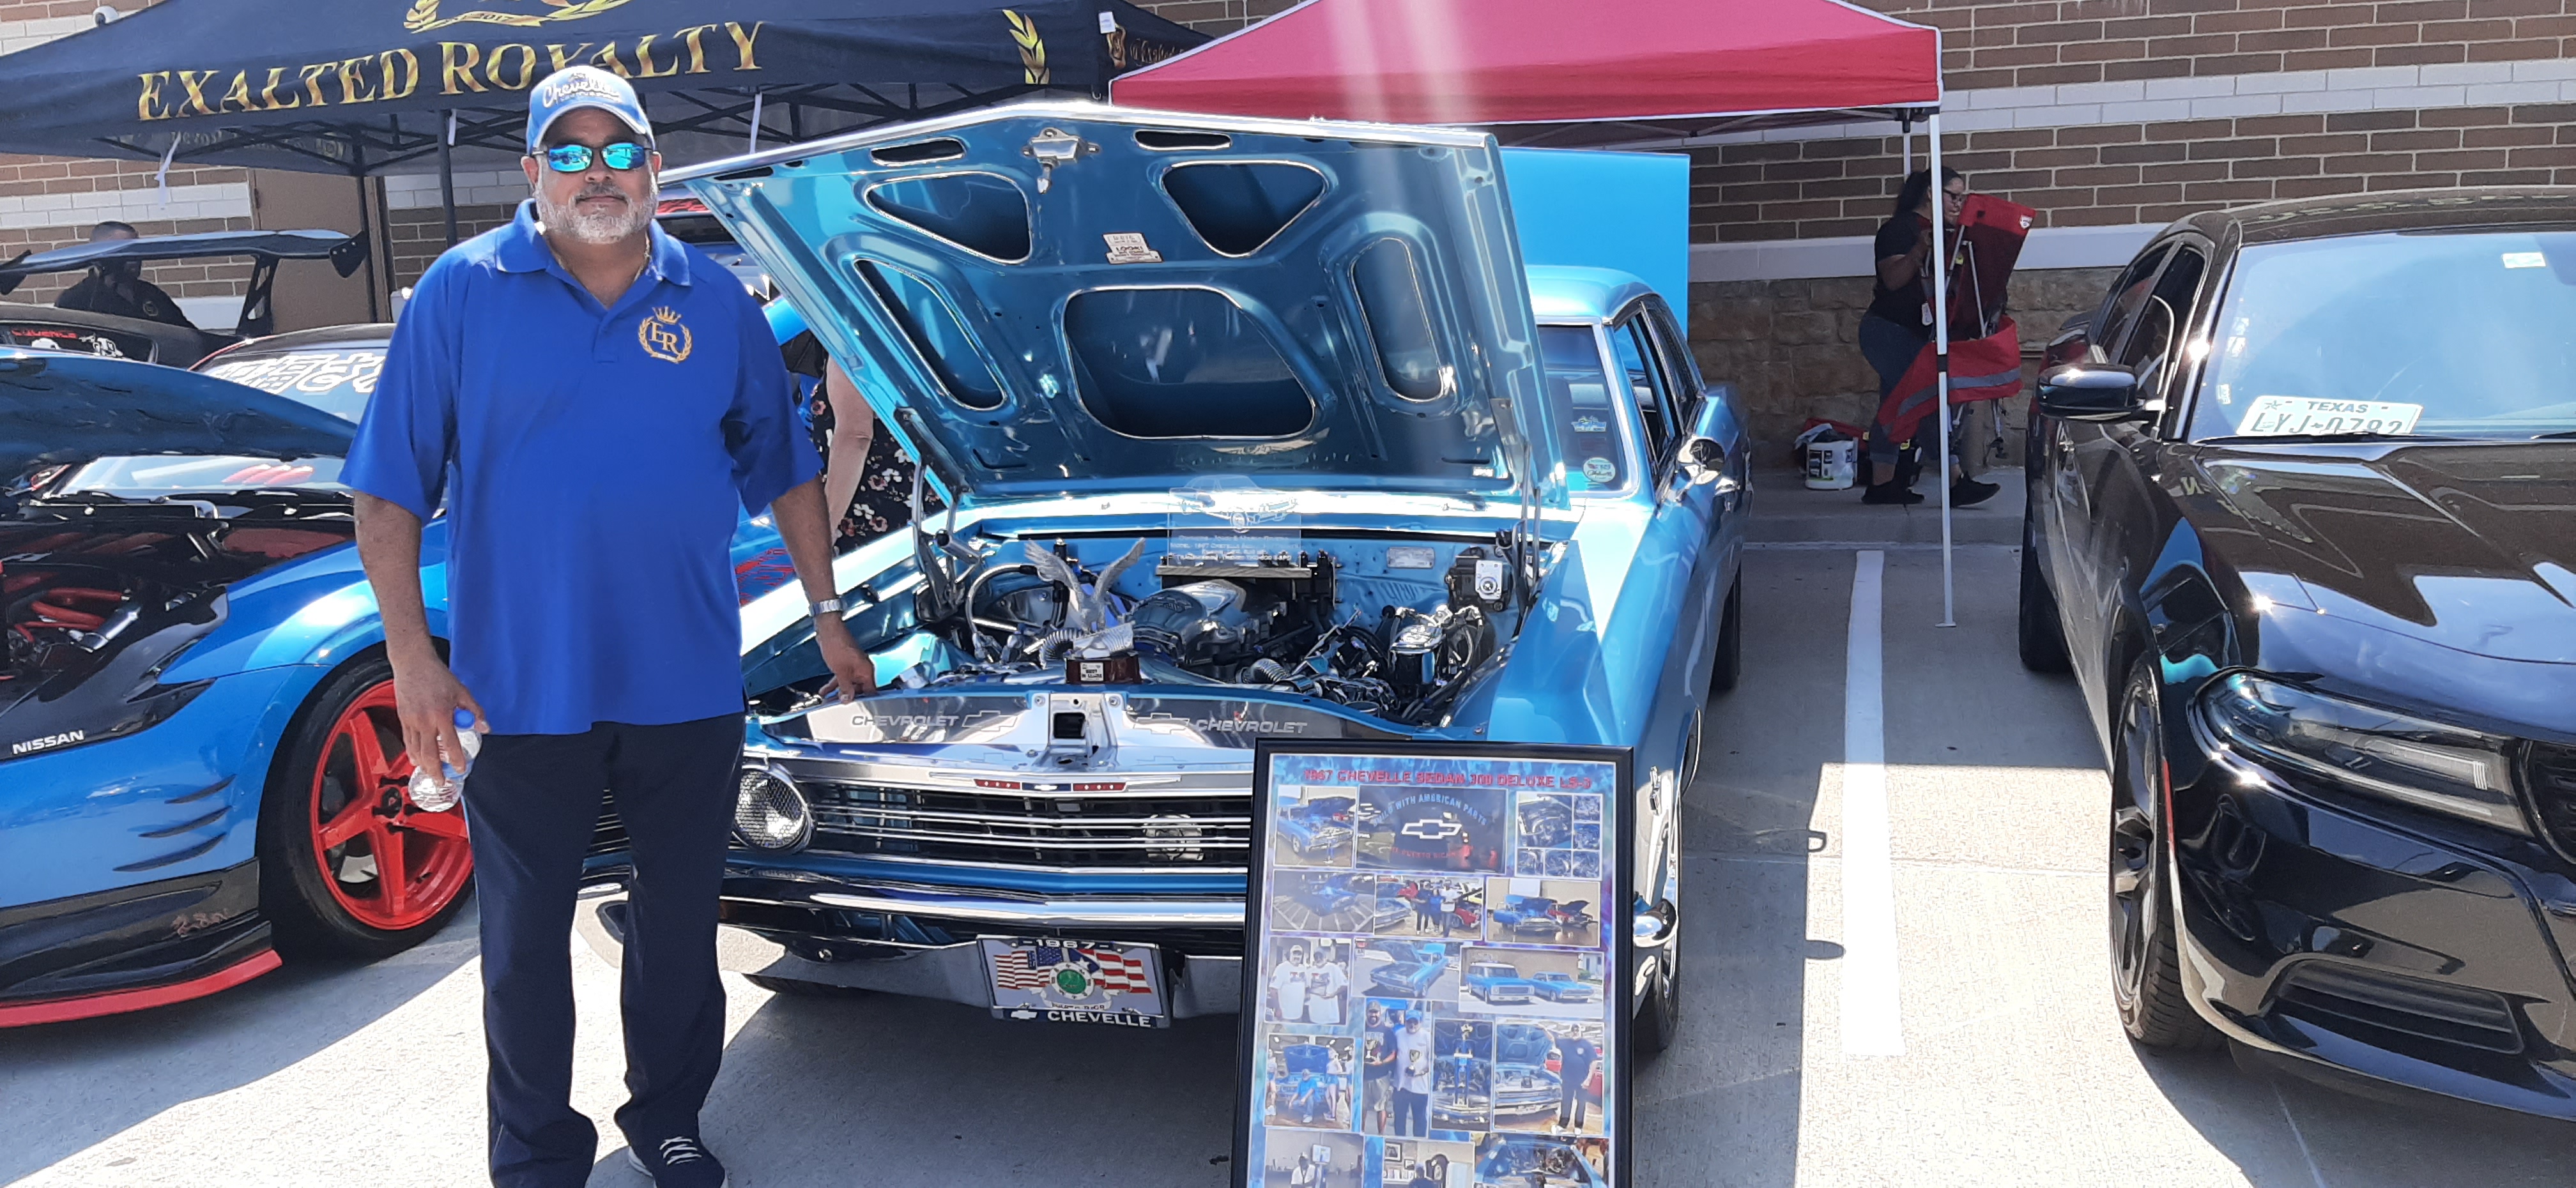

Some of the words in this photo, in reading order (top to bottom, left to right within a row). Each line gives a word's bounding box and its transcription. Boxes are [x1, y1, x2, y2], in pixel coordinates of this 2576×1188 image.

[137, 48, 419, 121] EXALTED
[437, 21, 772, 95] ROYALTY
[543, 77, 620, 108] Chevelle
[2307, 400, 2369, 413] TEXAS
[852, 715, 960, 726] CHEVROLET
[1196, 719, 1308, 734] CHEVROLET
[12, 729, 85, 755] NISSAN
[1337, 770, 1411, 783] CHEVELLE
[1497, 775, 1555, 788] DELUXE
[1036, 940, 1096, 949] 1967
[1046, 1010, 1151, 1027] CHEVELLE
